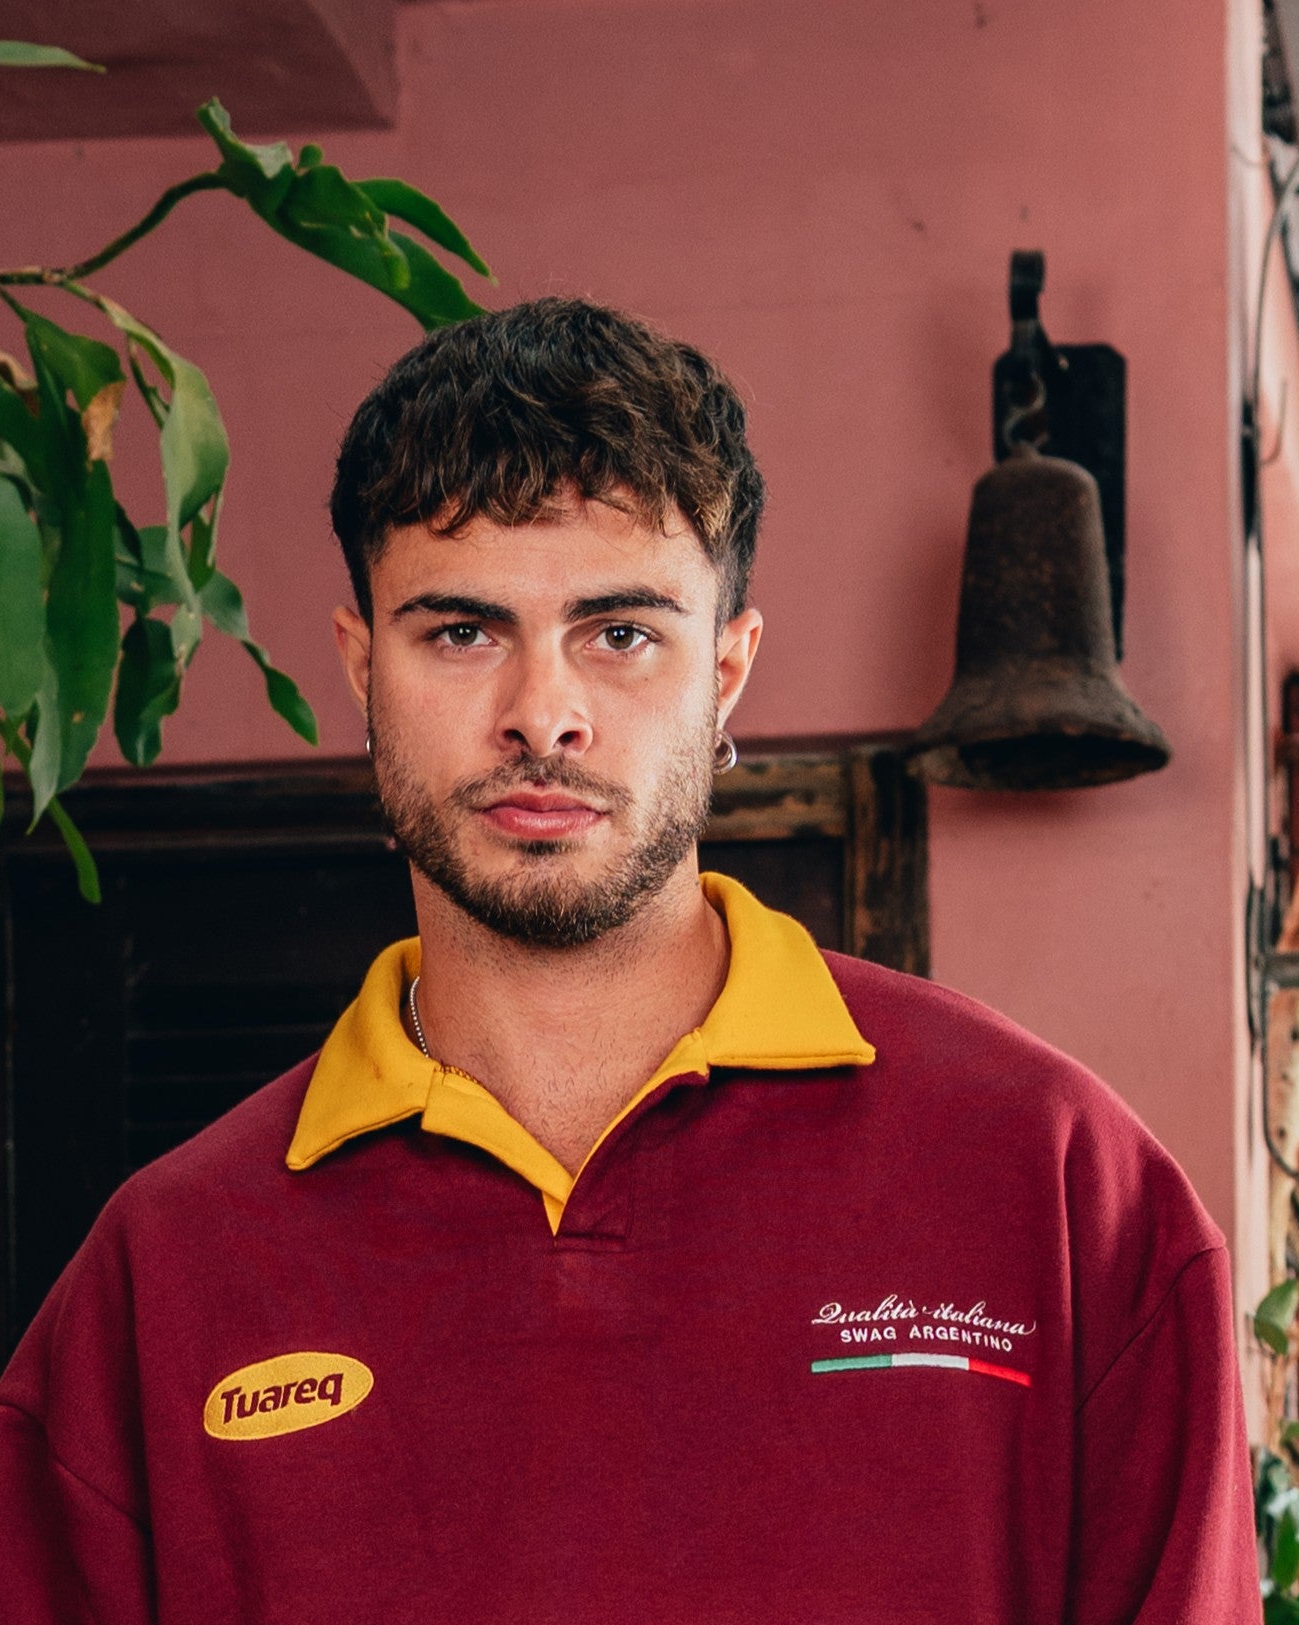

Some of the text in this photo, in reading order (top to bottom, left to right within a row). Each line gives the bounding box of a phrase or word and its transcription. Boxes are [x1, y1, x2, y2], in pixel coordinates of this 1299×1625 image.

[811, 1294, 1036, 1336] Qualità italiana
[840, 1325, 1013, 1352] SWAG ARGENTINO
